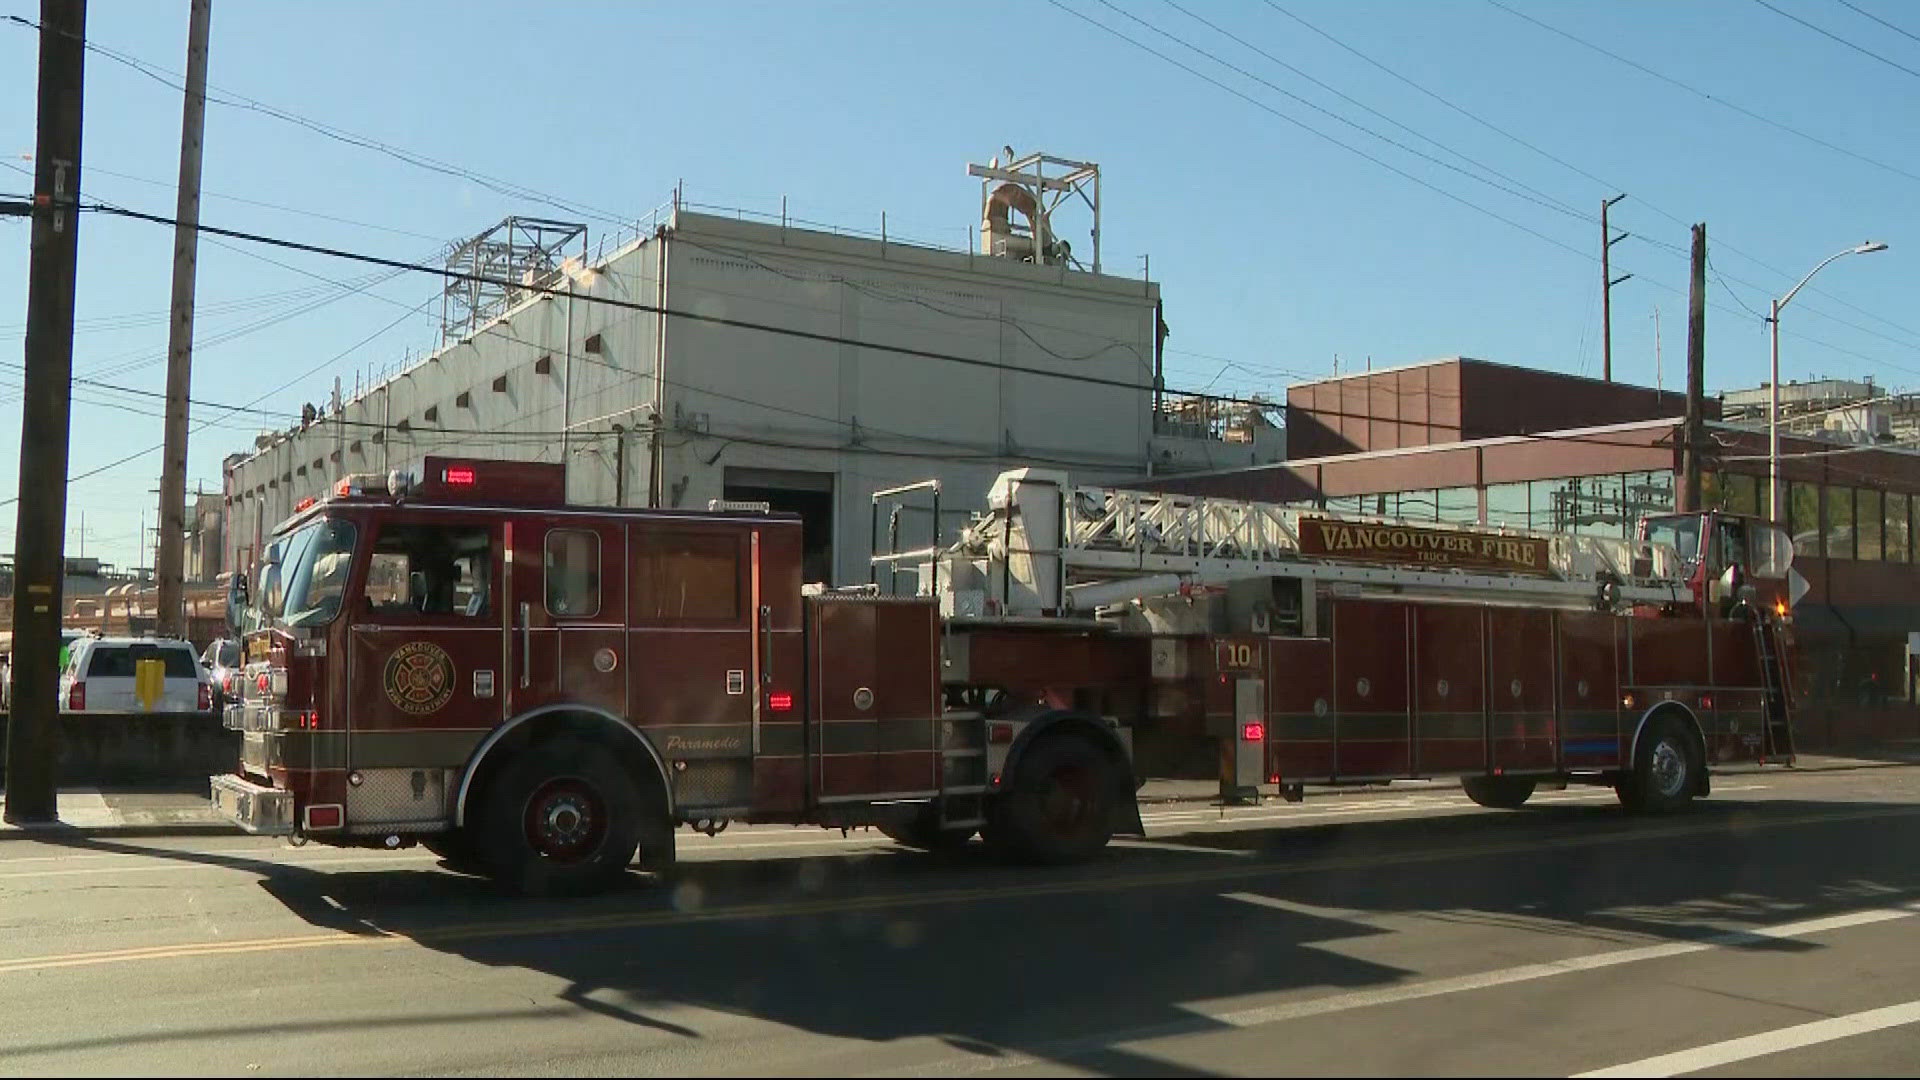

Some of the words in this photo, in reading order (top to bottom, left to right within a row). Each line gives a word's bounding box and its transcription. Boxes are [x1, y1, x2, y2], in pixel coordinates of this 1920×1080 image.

[1320, 525, 1473, 552] VANCOUVER
[1482, 540, 1535, 566] FIRE
[1417, 551, 1448, 562] TRUCK
[1227, 644, 1250, 667] 10
[667, 735, 740, 750] Paramedic
